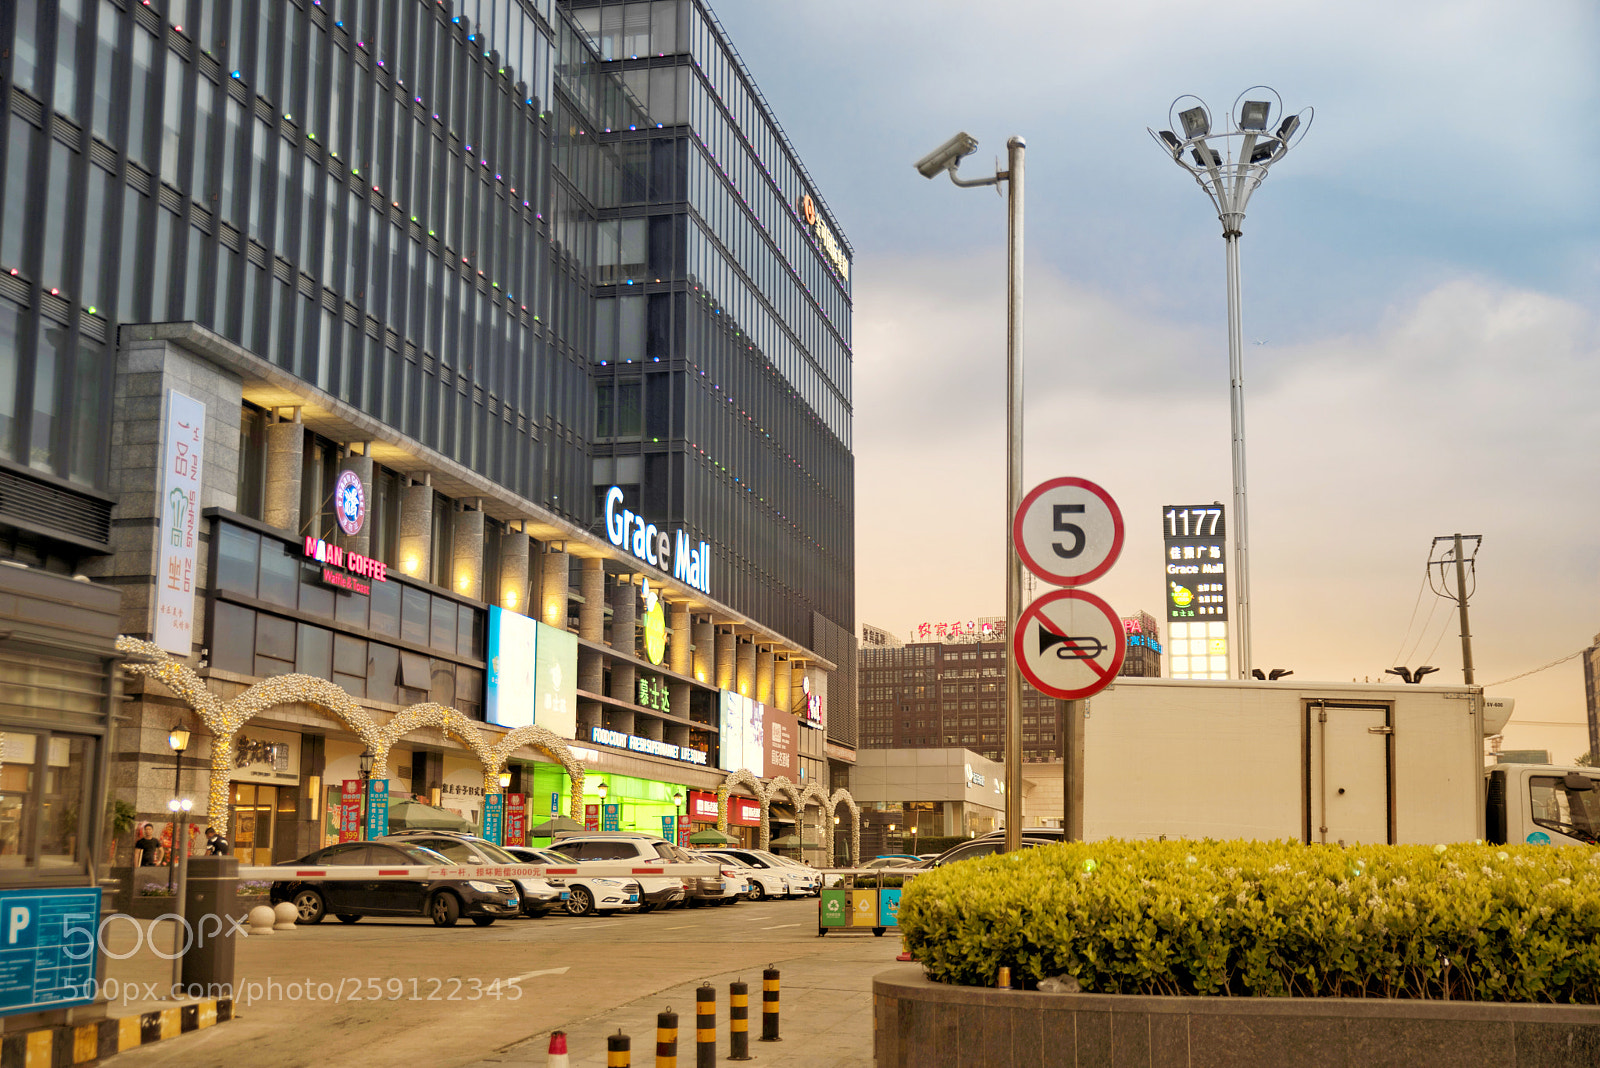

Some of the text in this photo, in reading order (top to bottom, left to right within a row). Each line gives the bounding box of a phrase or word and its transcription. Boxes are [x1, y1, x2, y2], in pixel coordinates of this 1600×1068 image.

[1052, 504, 1086, 559] 5
[1166, 508, 1221, 536] 1177
[605, 485, 711, 595] Grace Mall
[305, 535, 387, 582] MAAN COFFEE
[1167, 562, 1225, 574] Grace Mall
[183, 557, 192, 593] ZUO
[323, 568, 346, 587] Waffle
[353, 578, 370, 595] Toast
[918, 621, 964, 638] 农家乐
[592, 726, 609, 745] FOOD
[344, 831, 358, 840] 399
[511, 837, 522, 845] 399
[9, 906, 31, 944] P
